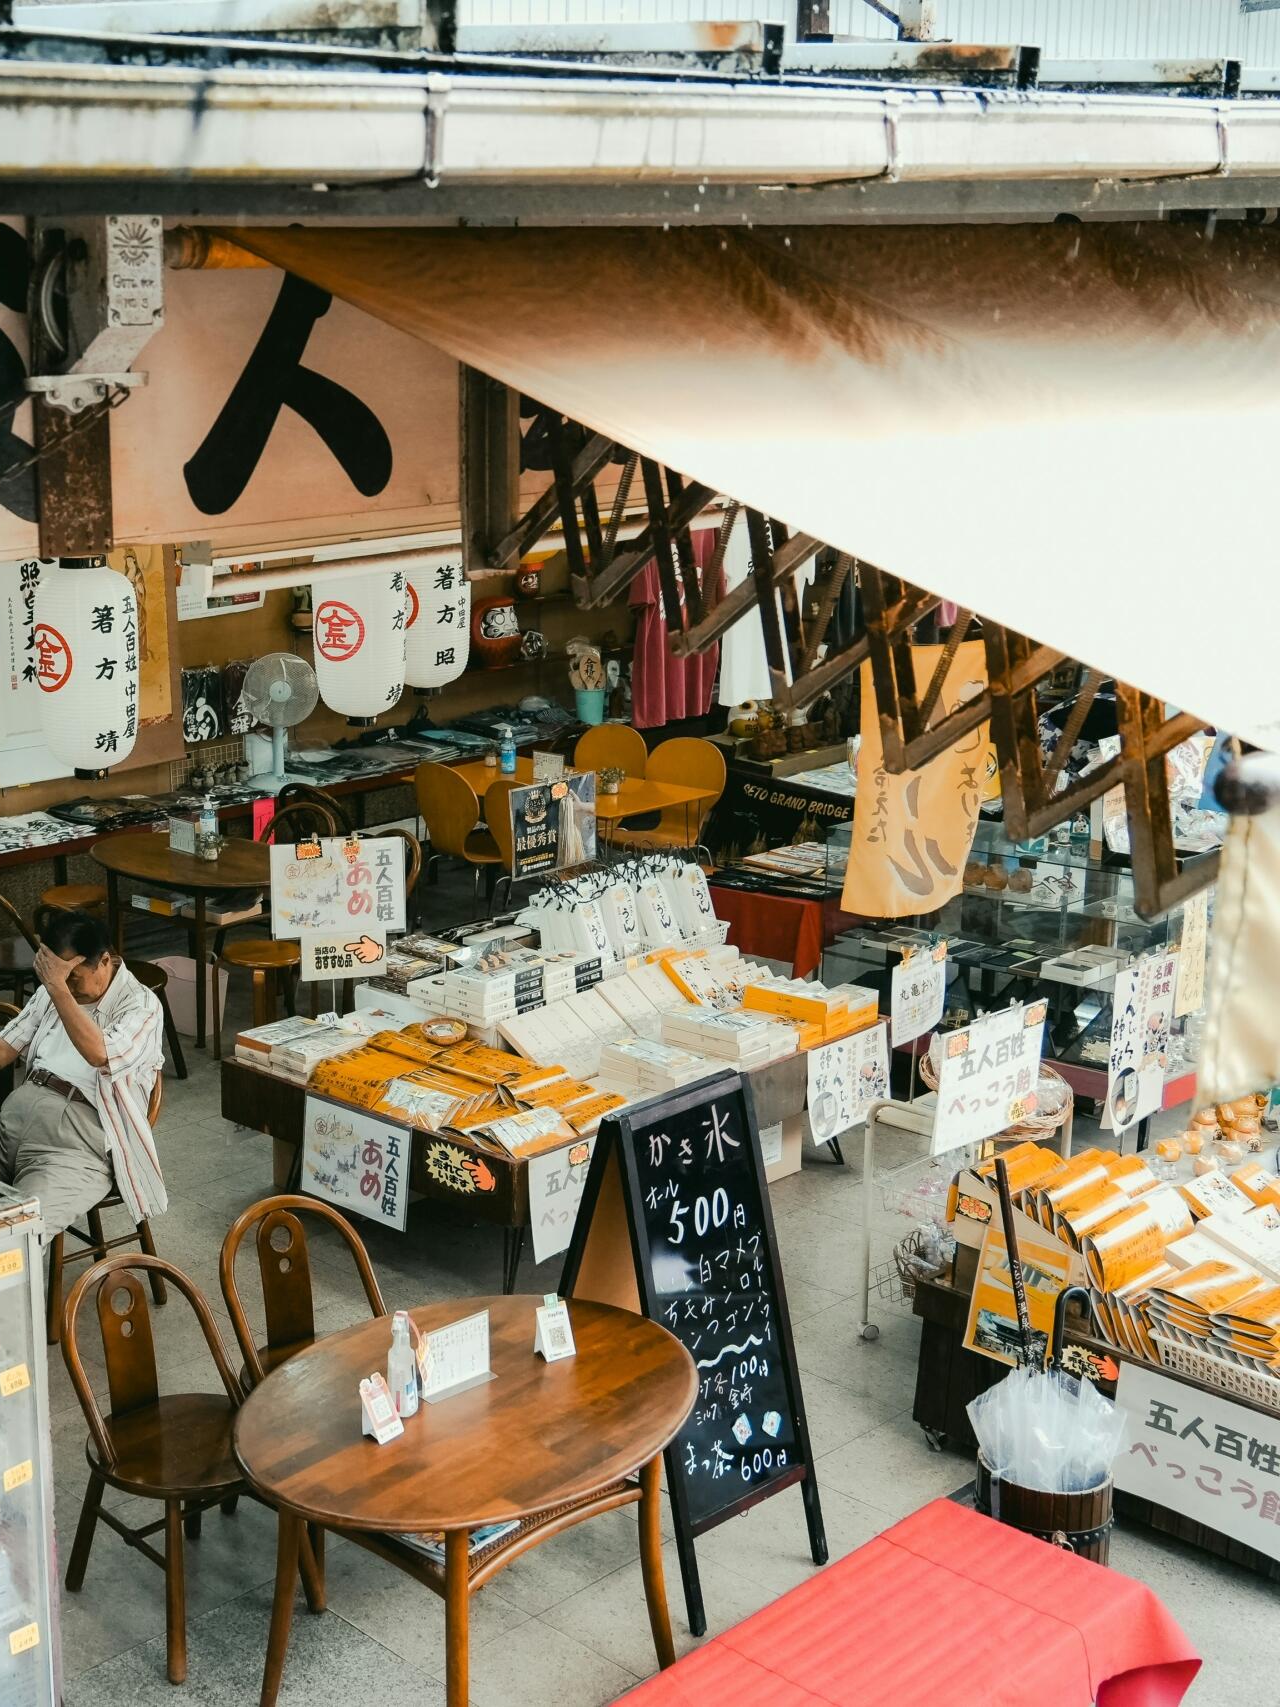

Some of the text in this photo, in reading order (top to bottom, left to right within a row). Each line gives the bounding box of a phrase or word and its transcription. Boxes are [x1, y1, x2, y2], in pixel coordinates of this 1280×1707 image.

[320, 609, 356, 650] 金
[36, 633, 63, 682] 金
[121, 595, 138, 739] 五人百姓 中田屋
[743, 783, 850, 820] SETO GRAND BRIDGE
[345, 861, 373, 916] あめ
[375, 848, 396, 922] 五人百姓
[314, 954, 353, 970] おすすめ品
[957, 1031, 1026, 1082] 五人百姓
[948, 1066, 1031, 1116] べっこう飴
[648, 1104, 741, 1168] かき氷
[359, 1138, 384, 1201] あめ
[380, 1135, 402, 1219] 五人百姓
[645, 1178, 679, 1210] オール
[667, 1187, 746, 1244] 500円
[731, 1355, 769, 1386] 100円
[684, 1439, 788, 1482] まっ茶 600円
[1144, 1398, 1280, 1478] 五人百姓
